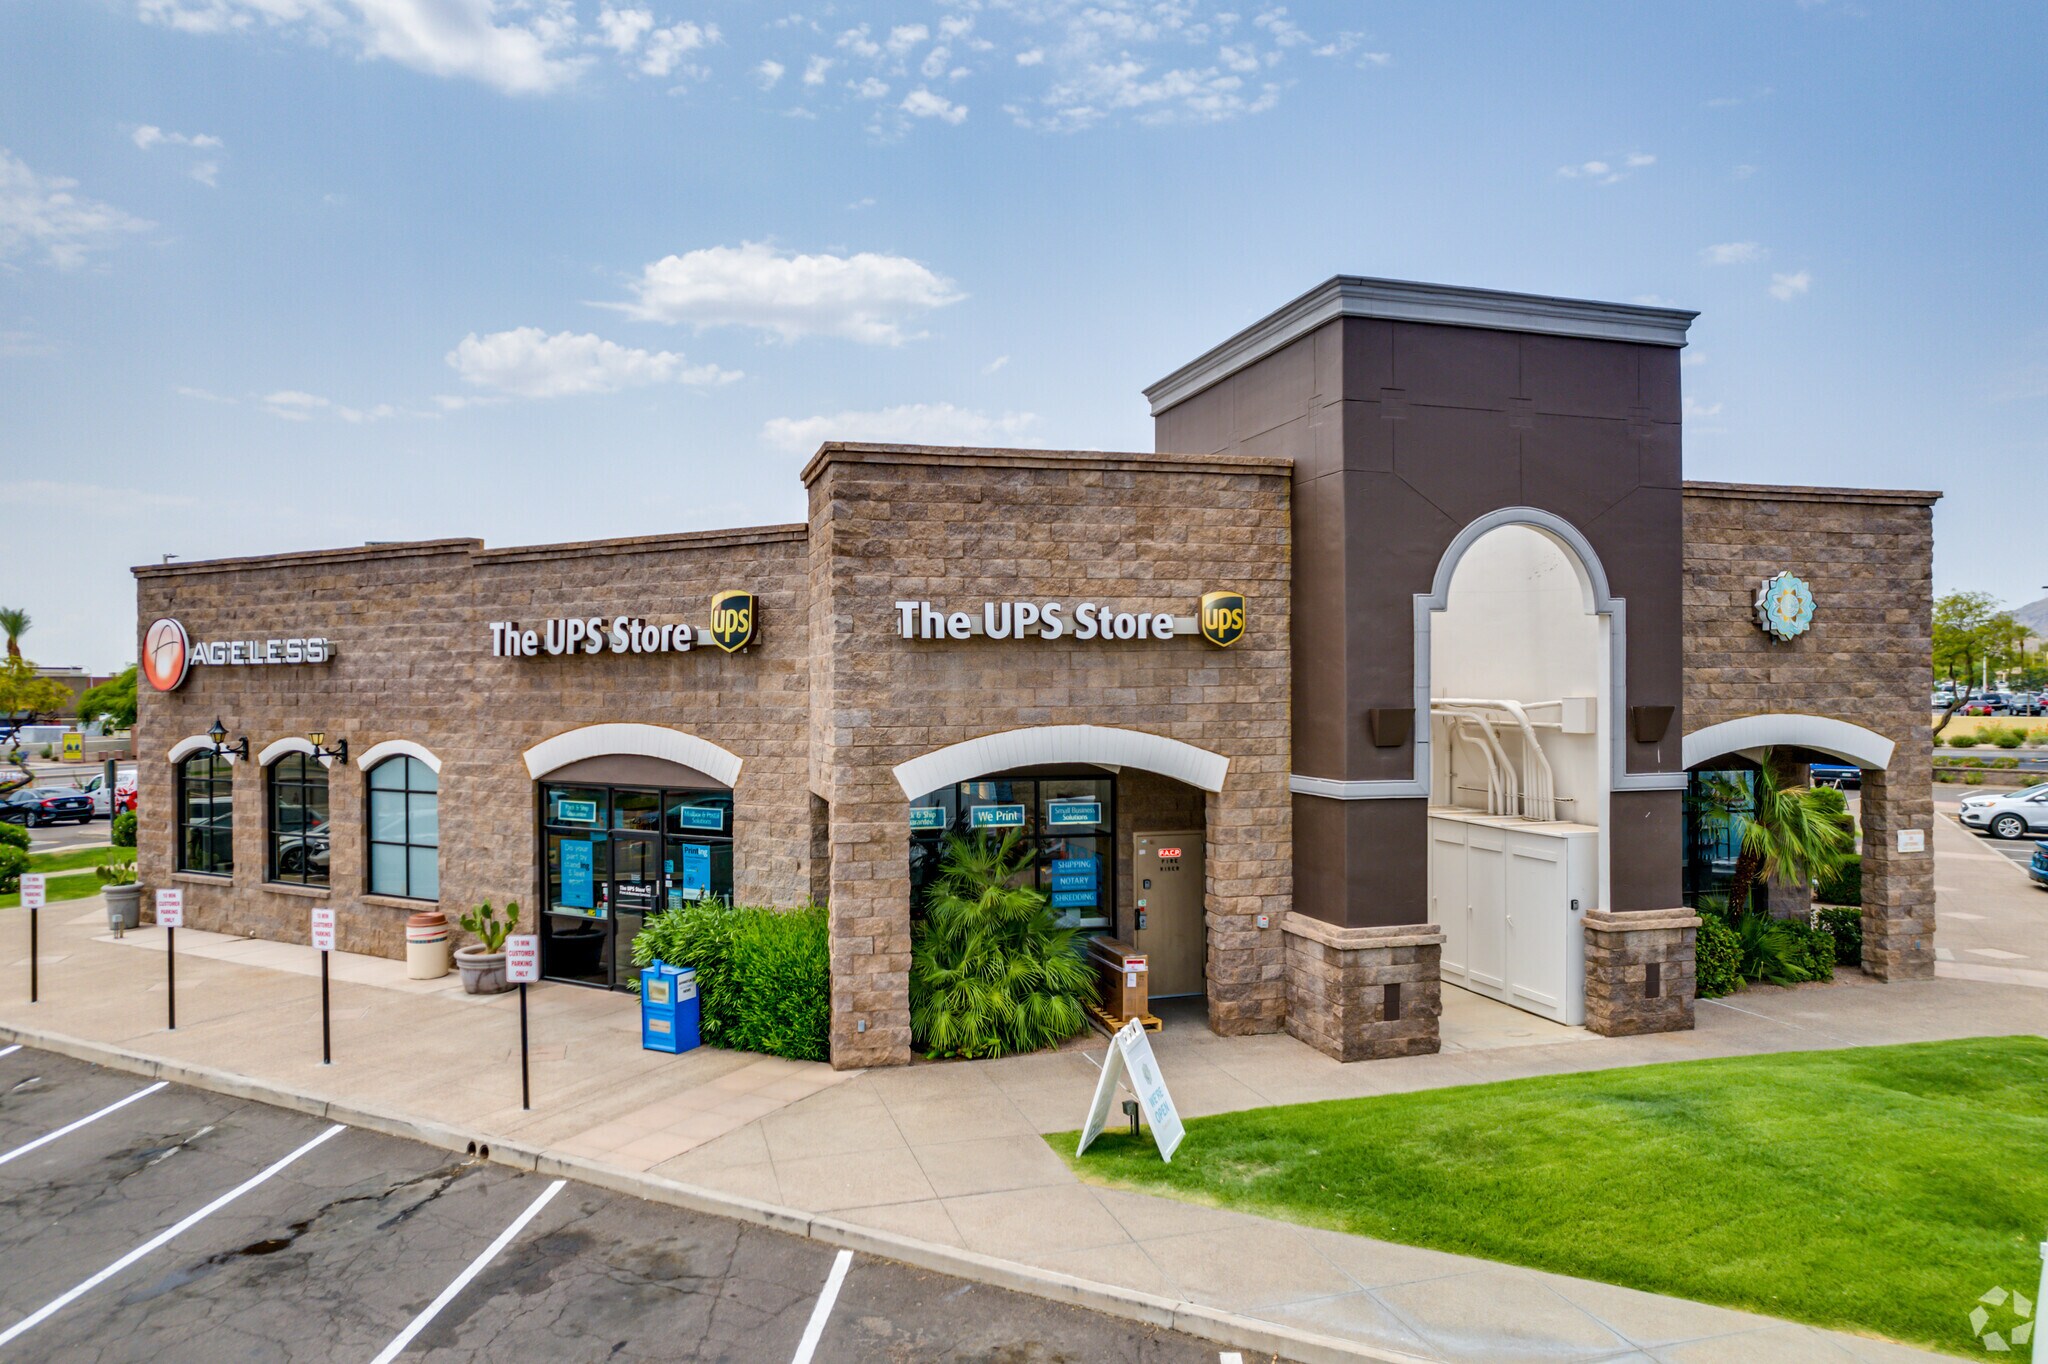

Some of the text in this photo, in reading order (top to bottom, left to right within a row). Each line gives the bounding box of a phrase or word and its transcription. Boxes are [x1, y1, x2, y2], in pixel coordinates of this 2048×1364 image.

[713, 608, 749, 643] ups
[895, 601, 1175, 640] The UPS Store
[1206, 606, 1243, 639] ups
[489, 615, 692, 657] The UPS Store
[190, 637, 330, 666] AGELESS
[923, 811, 937, 819] Ship
[978, 810, 1018, 822] We Print
[1072, 806, 1096, 814] Business
[1062, 813, 1088, 821] Solutions
[684, 846, 708, 858] Printing
[1058, 860, 1092, 869] SHIPPING
[1060, 876, 1089, 885] NOTARY
[1055, 892, 1095, 902] SHREDDING
[1154, 1100, 1170, 1123] OPEN
